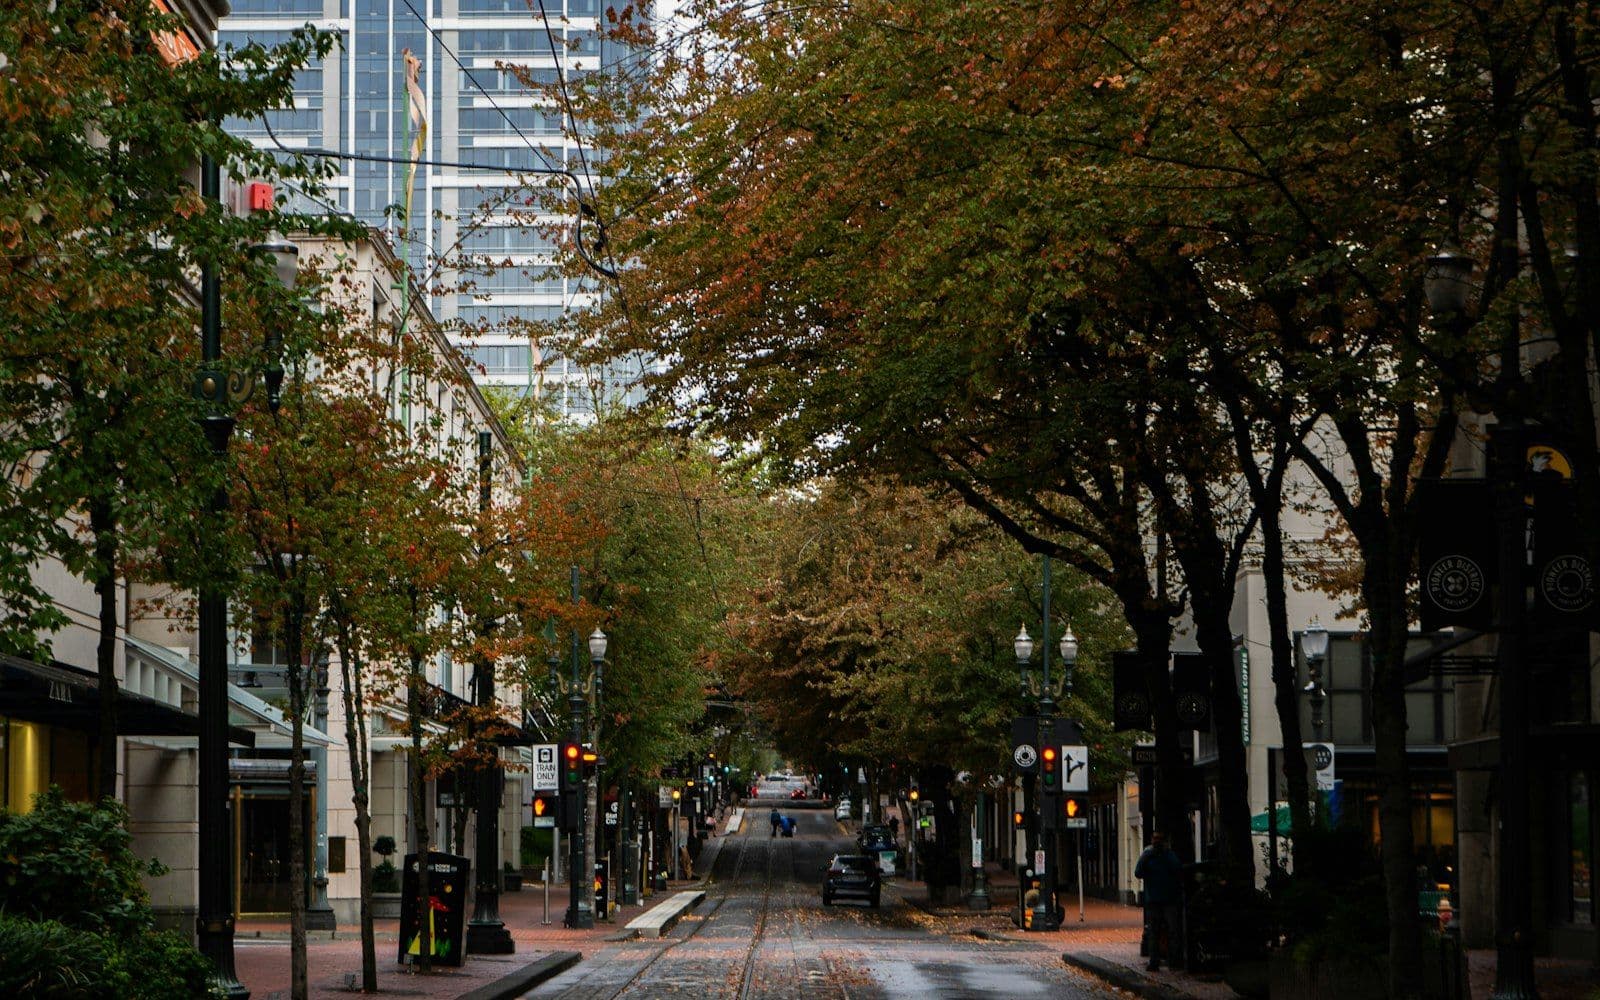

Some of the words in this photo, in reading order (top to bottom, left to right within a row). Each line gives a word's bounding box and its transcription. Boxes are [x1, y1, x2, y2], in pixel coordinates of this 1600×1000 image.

[1430, 559, 1454, 592] PIONEER
[1456, 559, 1480, 592] DISTRICT
[536, 763, 556, 772] TRAIN
